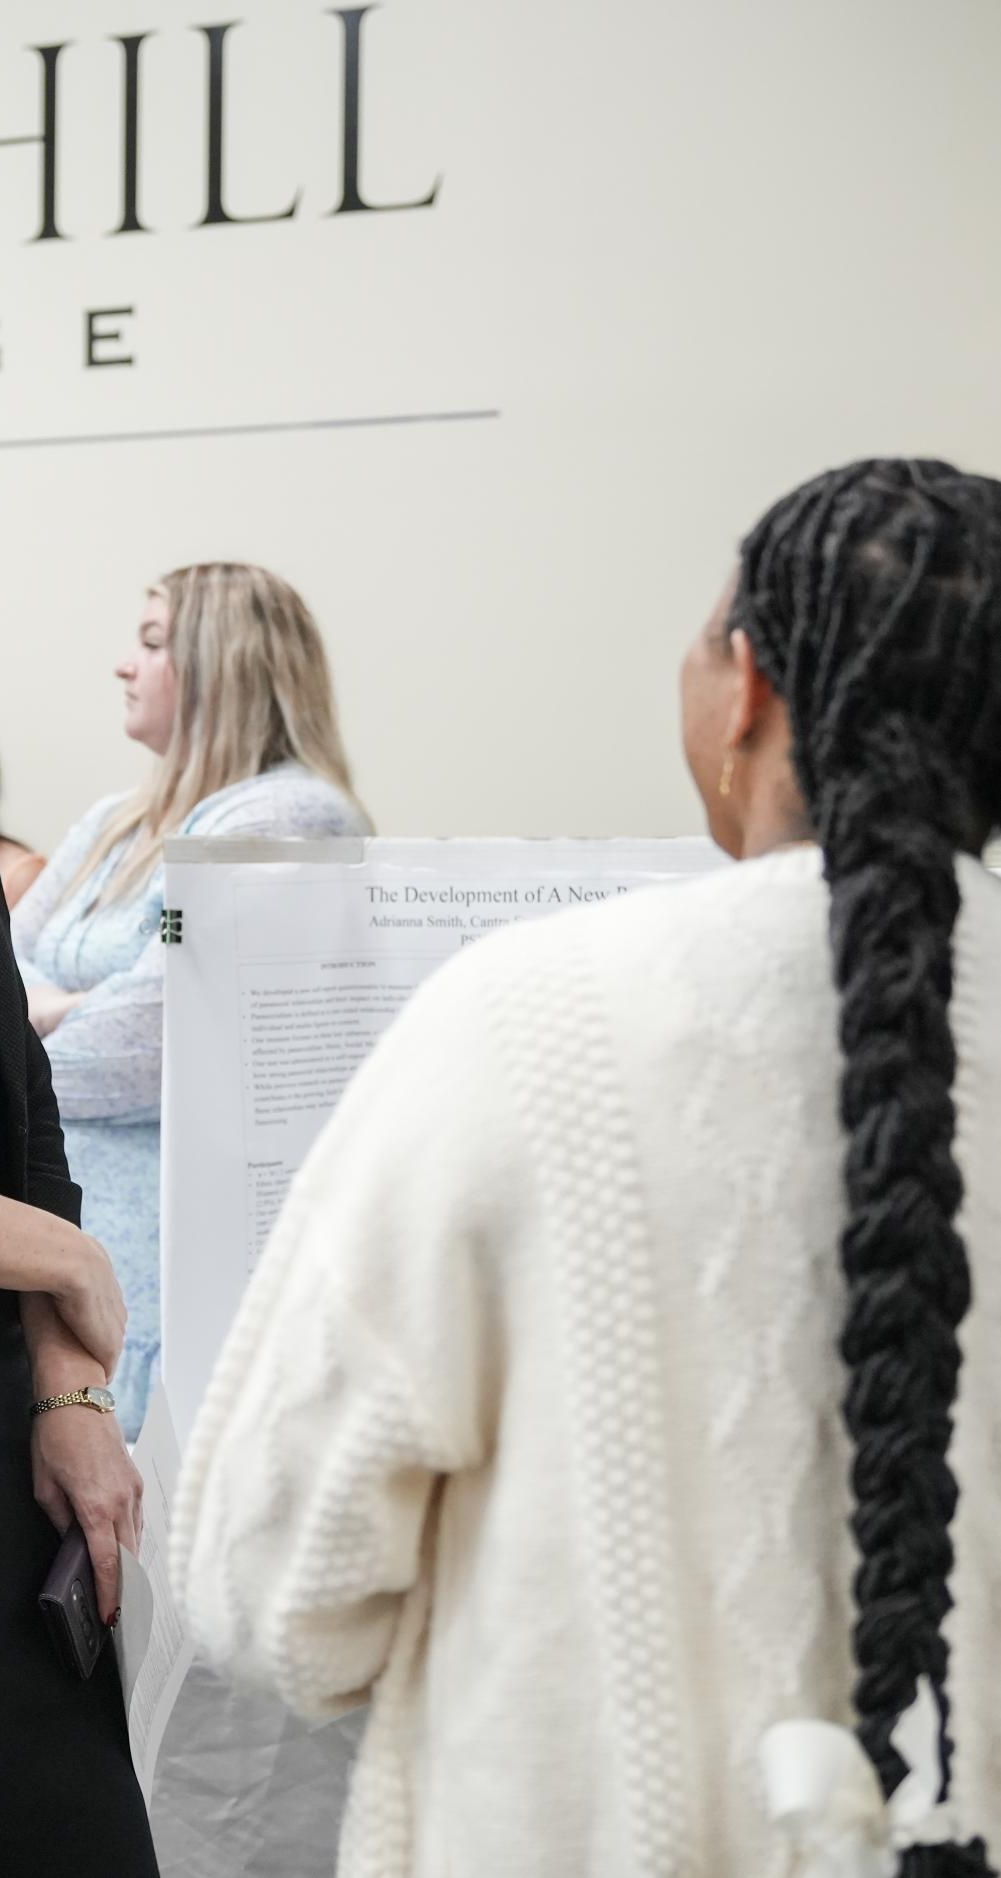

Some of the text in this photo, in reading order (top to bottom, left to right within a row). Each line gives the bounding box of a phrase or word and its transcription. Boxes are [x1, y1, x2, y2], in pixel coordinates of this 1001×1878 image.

[365, 885, 399, 904] The
[404, 885, 519, 908] Development
[524, 885, 545, 904] of
[547, 886, 563, 904] A
[567, 885, 611, 904] New
[369, 914, 423, 929] Adrianna
[460, 933, 484, 947] PS
